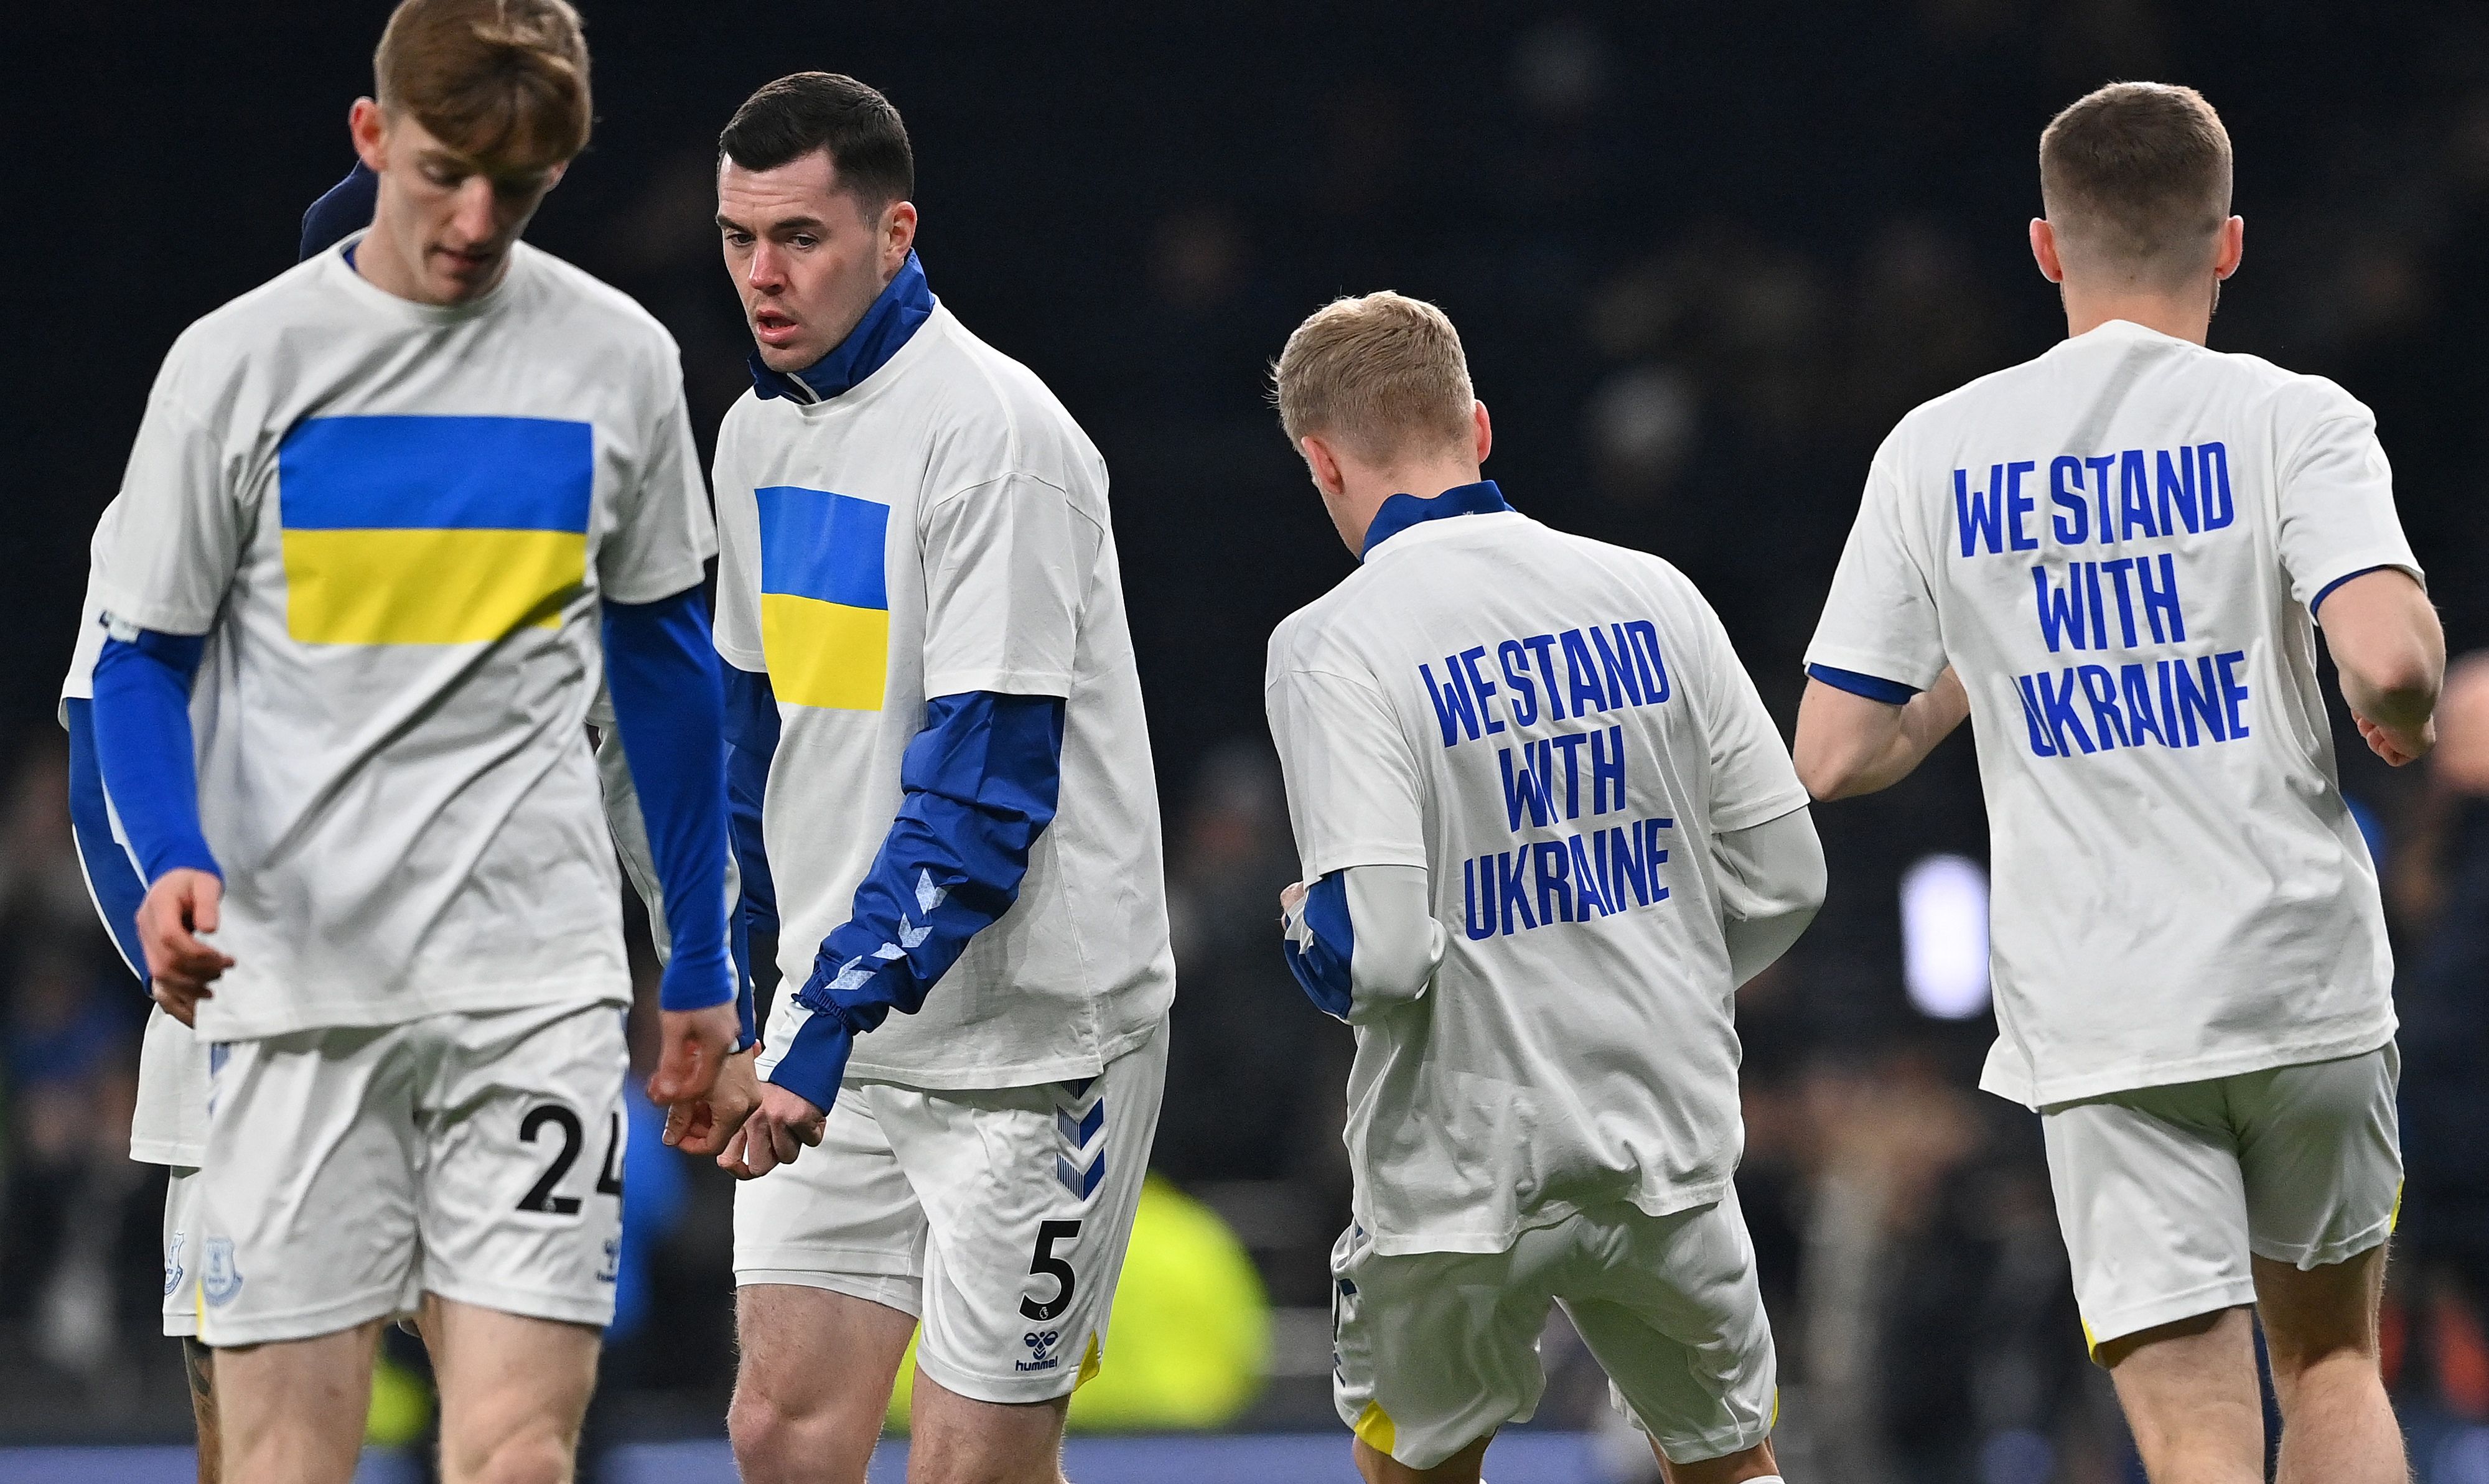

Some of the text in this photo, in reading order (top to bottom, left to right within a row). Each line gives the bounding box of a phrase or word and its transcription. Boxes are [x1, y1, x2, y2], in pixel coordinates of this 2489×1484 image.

[1954, 441, 2234, 558] WE STAND
[2032, 553, 2186, 653] WITH
[1419, 620, 1671, 748] WE STAND
[2010, 651, 2249, 757] UKRAINE
[1499, 725, 1626, 833] WITH
[1464, 818, 1673, 941] UKRAINE
[1018, 1219, 1083, 1323] 5
[1015, 1355, 1058, 1371] hummel
